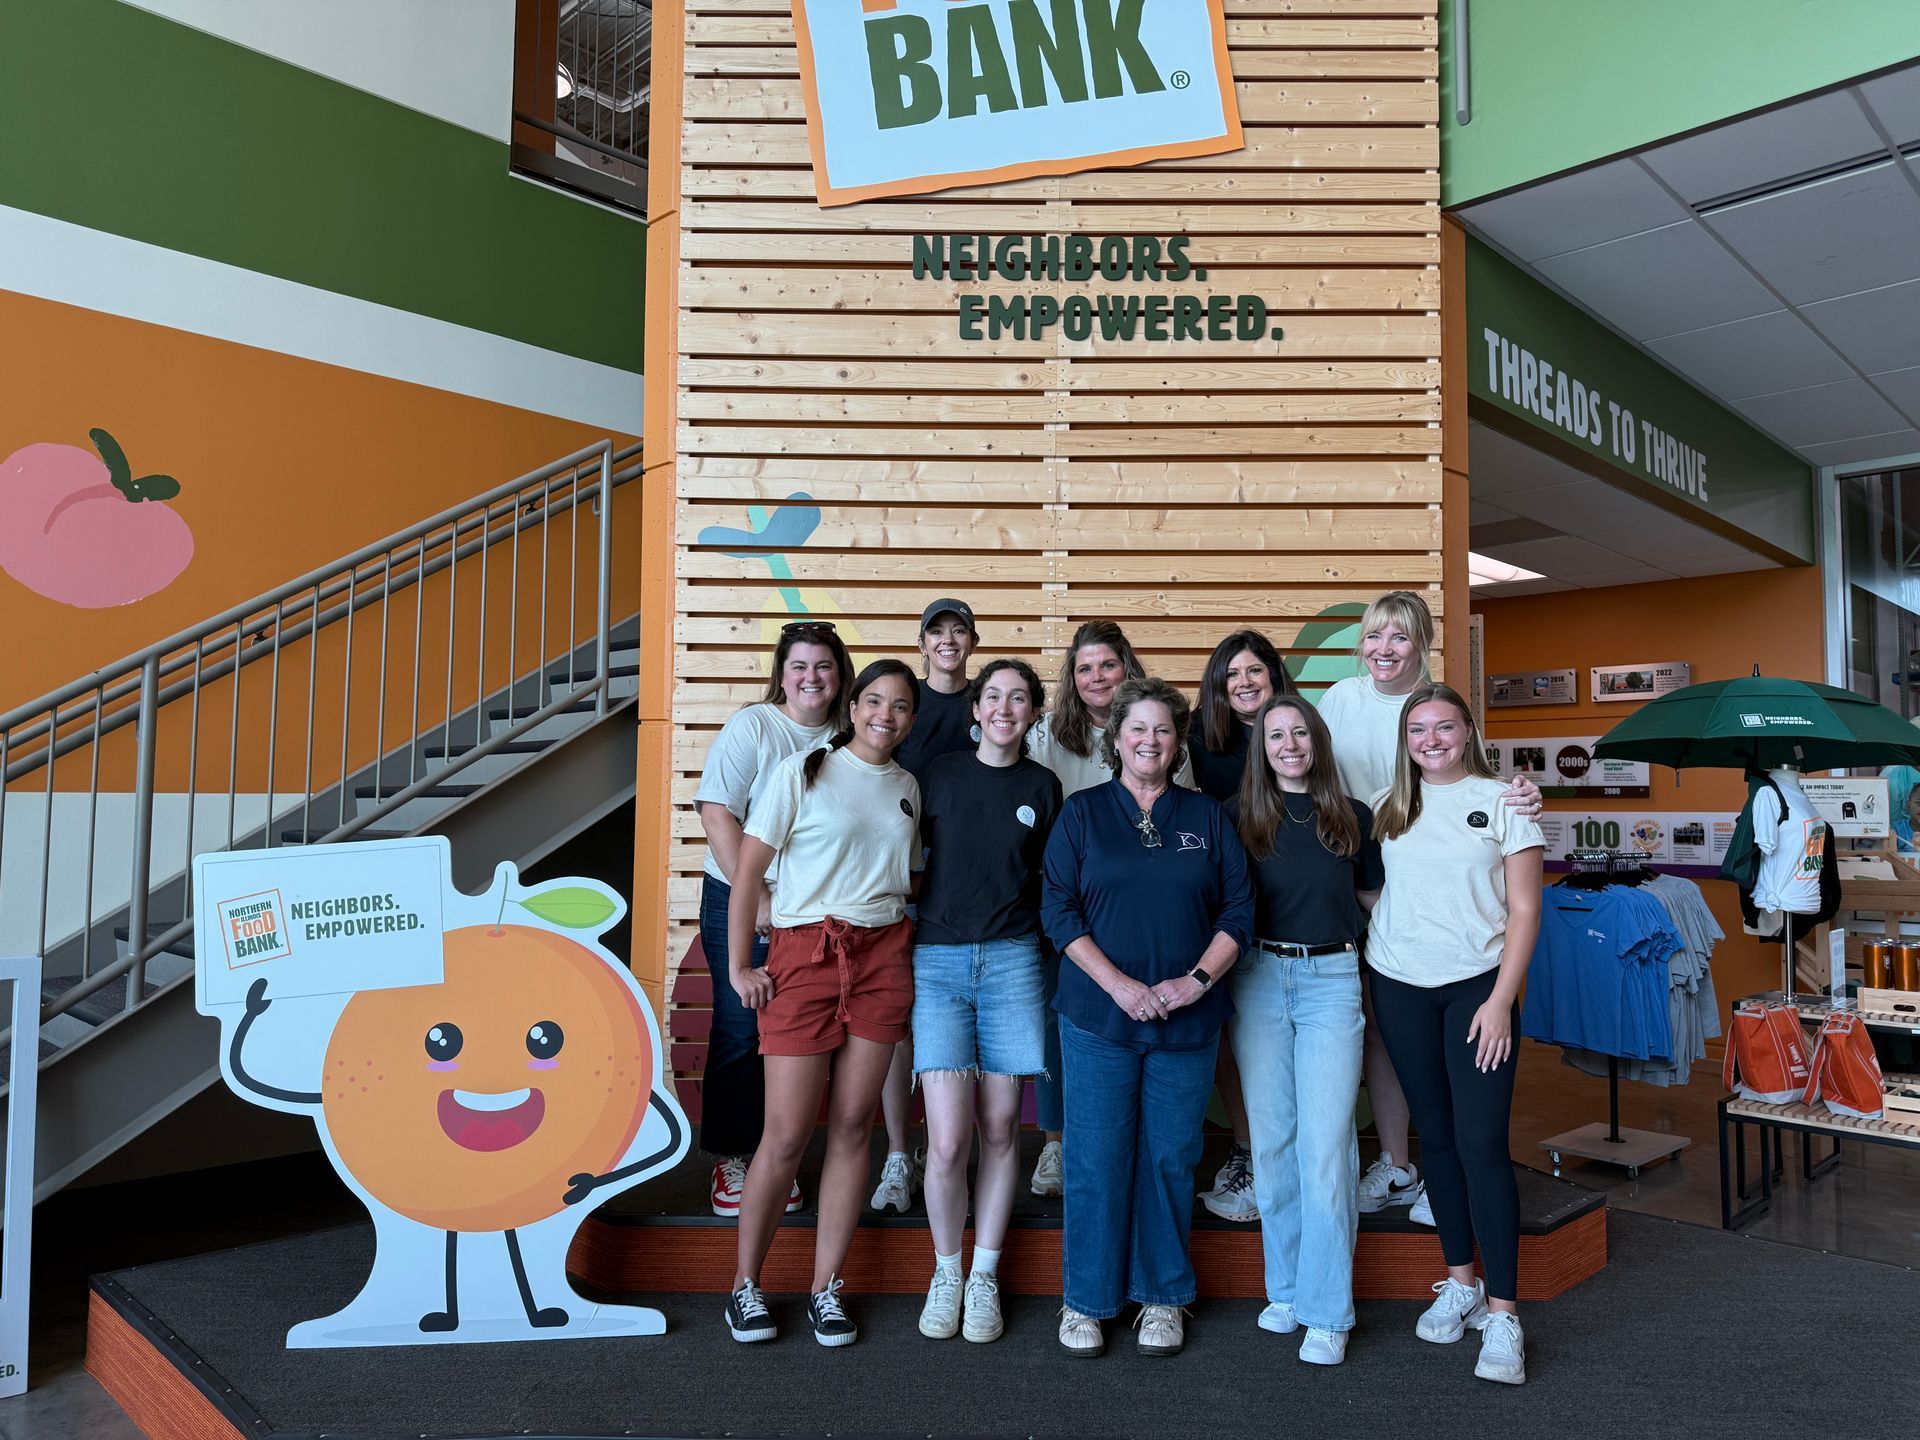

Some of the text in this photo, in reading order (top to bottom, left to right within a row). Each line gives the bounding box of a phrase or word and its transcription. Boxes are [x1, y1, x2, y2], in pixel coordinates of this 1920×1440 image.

[912, 234, 1207, 281] NEIGHBORS.
[959, 294, 1283, 341] EMPOWERED.
[1484, 327, 1708, 503] THREADS TO THRIVE
[1559, 756, 1589, 768] 2000s
[1604, 787, 1620, 795] 2000
[1571, 821, 1620, 848] 100
[229, 900, 272, 919] NORTHERN
[291, 894, 400, 920] NEIGHBORS.
[305, 913, 425, 941] EMPOWERED.
[234, 931, 280, 958] BANK
